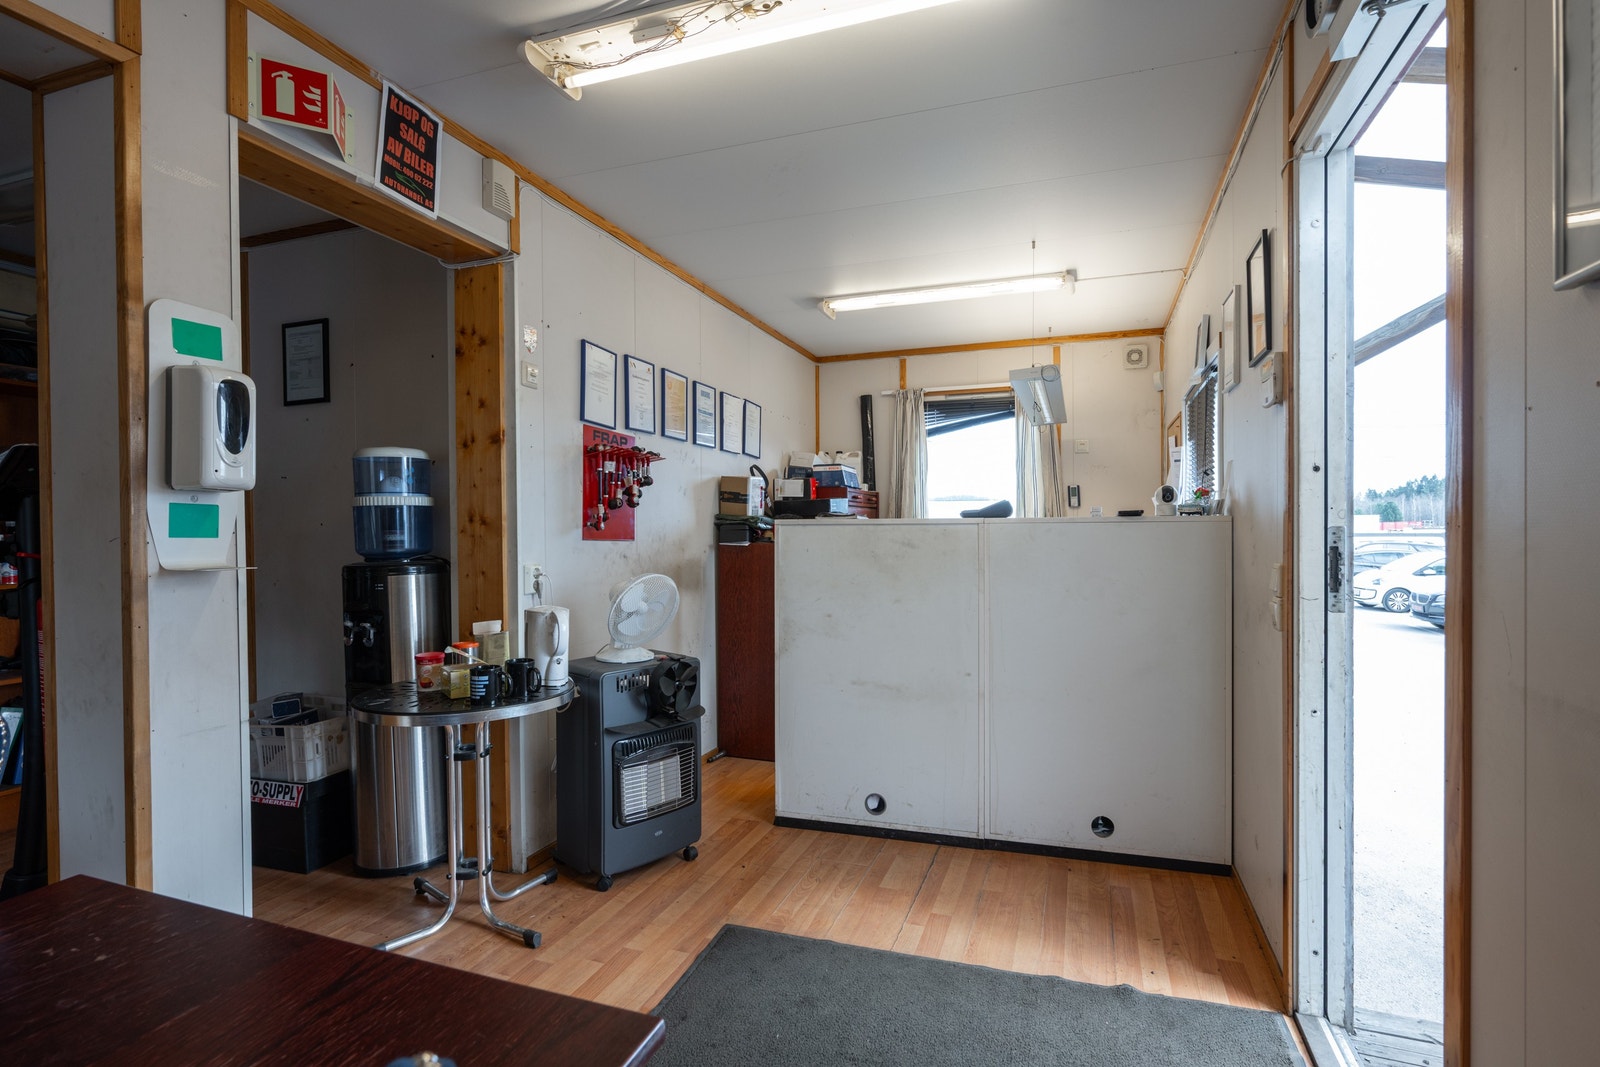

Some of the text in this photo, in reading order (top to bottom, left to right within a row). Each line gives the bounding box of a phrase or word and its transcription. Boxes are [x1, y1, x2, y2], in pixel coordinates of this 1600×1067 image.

[389, 95, 434, 138] KJØP OG
[399, 122, 426, 153] SALG
[387, 136, 434, 179] AV BILER
[384, 175, 433, 209] AUTOHANDEL AS
[422, 178, 433, 190] 222
[261, 798, 297, 807] MERKER
